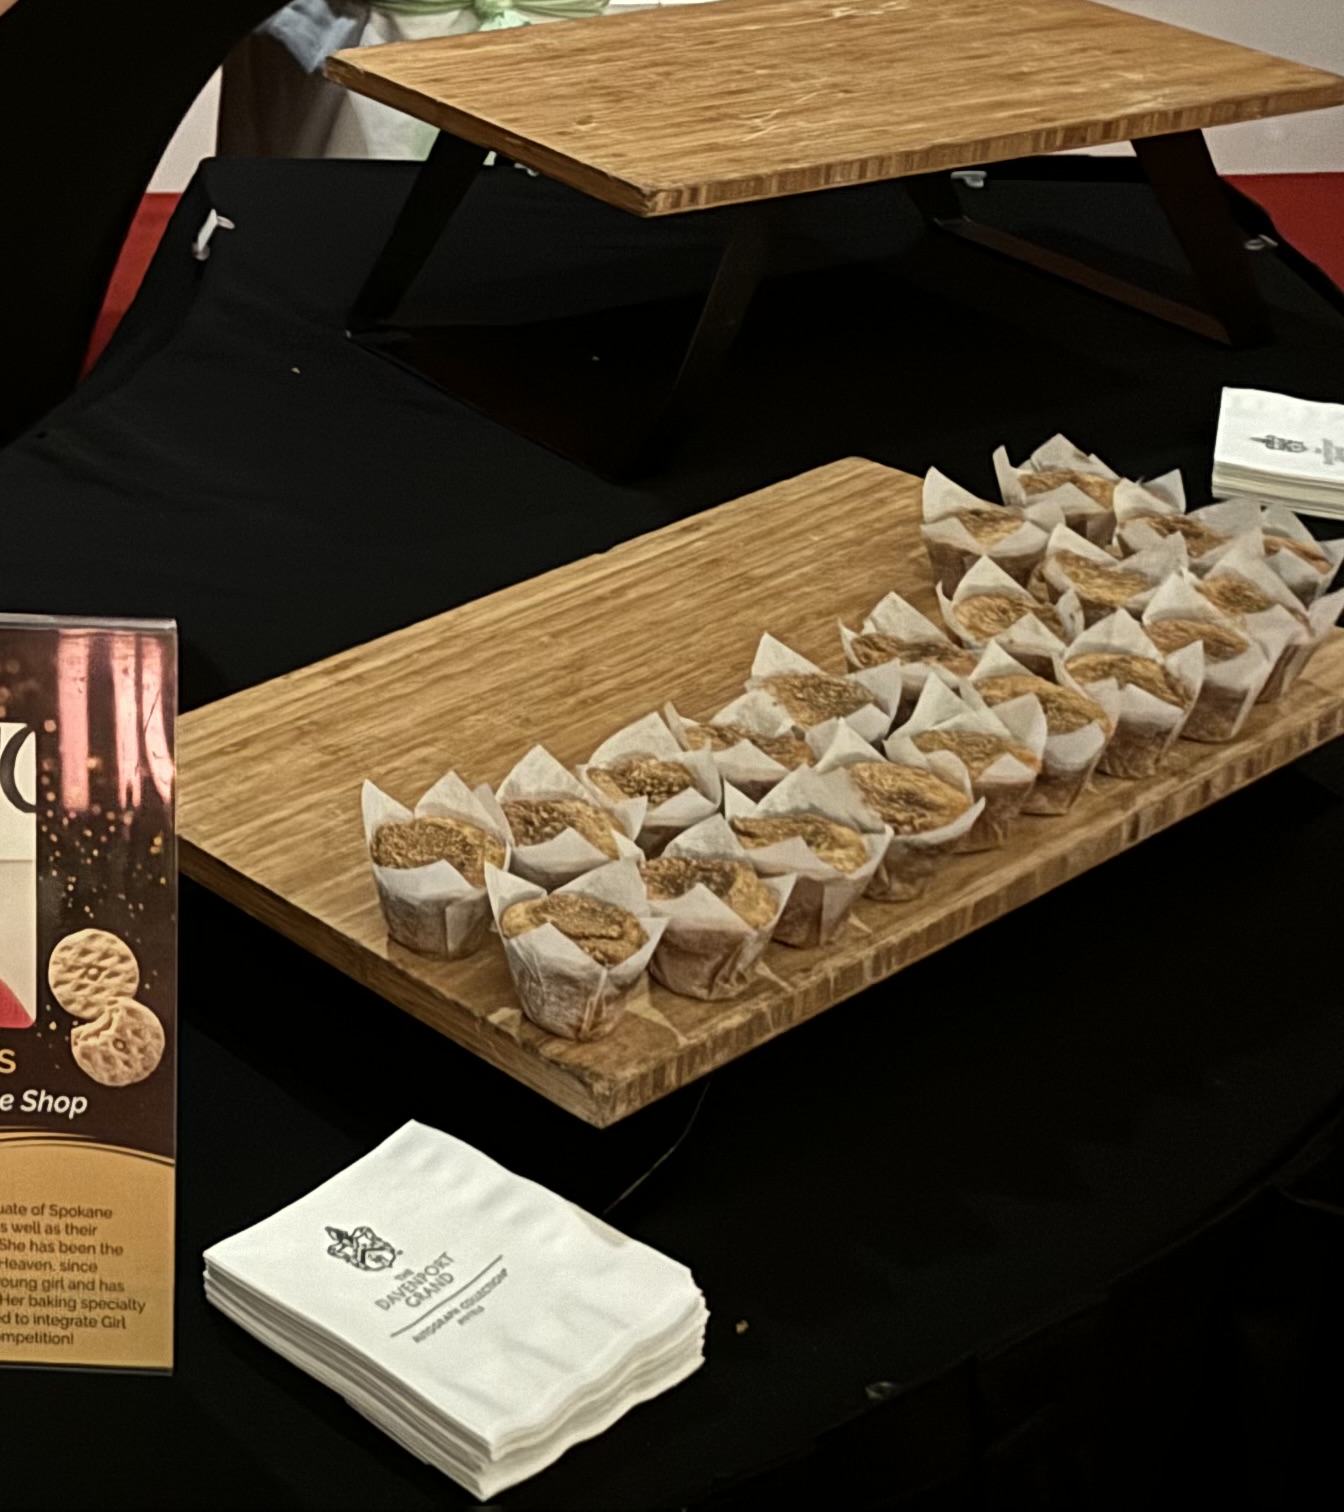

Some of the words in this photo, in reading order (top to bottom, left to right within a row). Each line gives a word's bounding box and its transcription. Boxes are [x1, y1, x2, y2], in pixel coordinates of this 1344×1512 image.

[20, 1089, 88, 1120] Shop
[31, 1203, 46, 1216] of
[49, 1204, 114, 1219] Spokane
[11, 1221, 41, 1234] well
[45, 1224, 61, 1235] as
[65, 1223, 98, 1236] their
[30, 1240, 56, 1253] has
[59, 1241, 97, 1254] been
[100, 1243, 124, 1256] the
[60, 1260, 98, 1273] since
[42, 1277, 65, 1292] girl
[68, 1279, 96, 1291] and
[99, 1279, 126, 1292] has
[374, 1251, 455, 1311] DAVENPORT
[405, 1272, 454, 1308] GRAND
[0, 1293, 25, 1306] Her
[28, 1295, 77, 1312] baking
[81, 1298, 146, 1314] specialty
[15, 1313, 30, 1325] to
[33, 1314, 98, 1330] integrate
[101, 1315, 127, 1330] Girl
